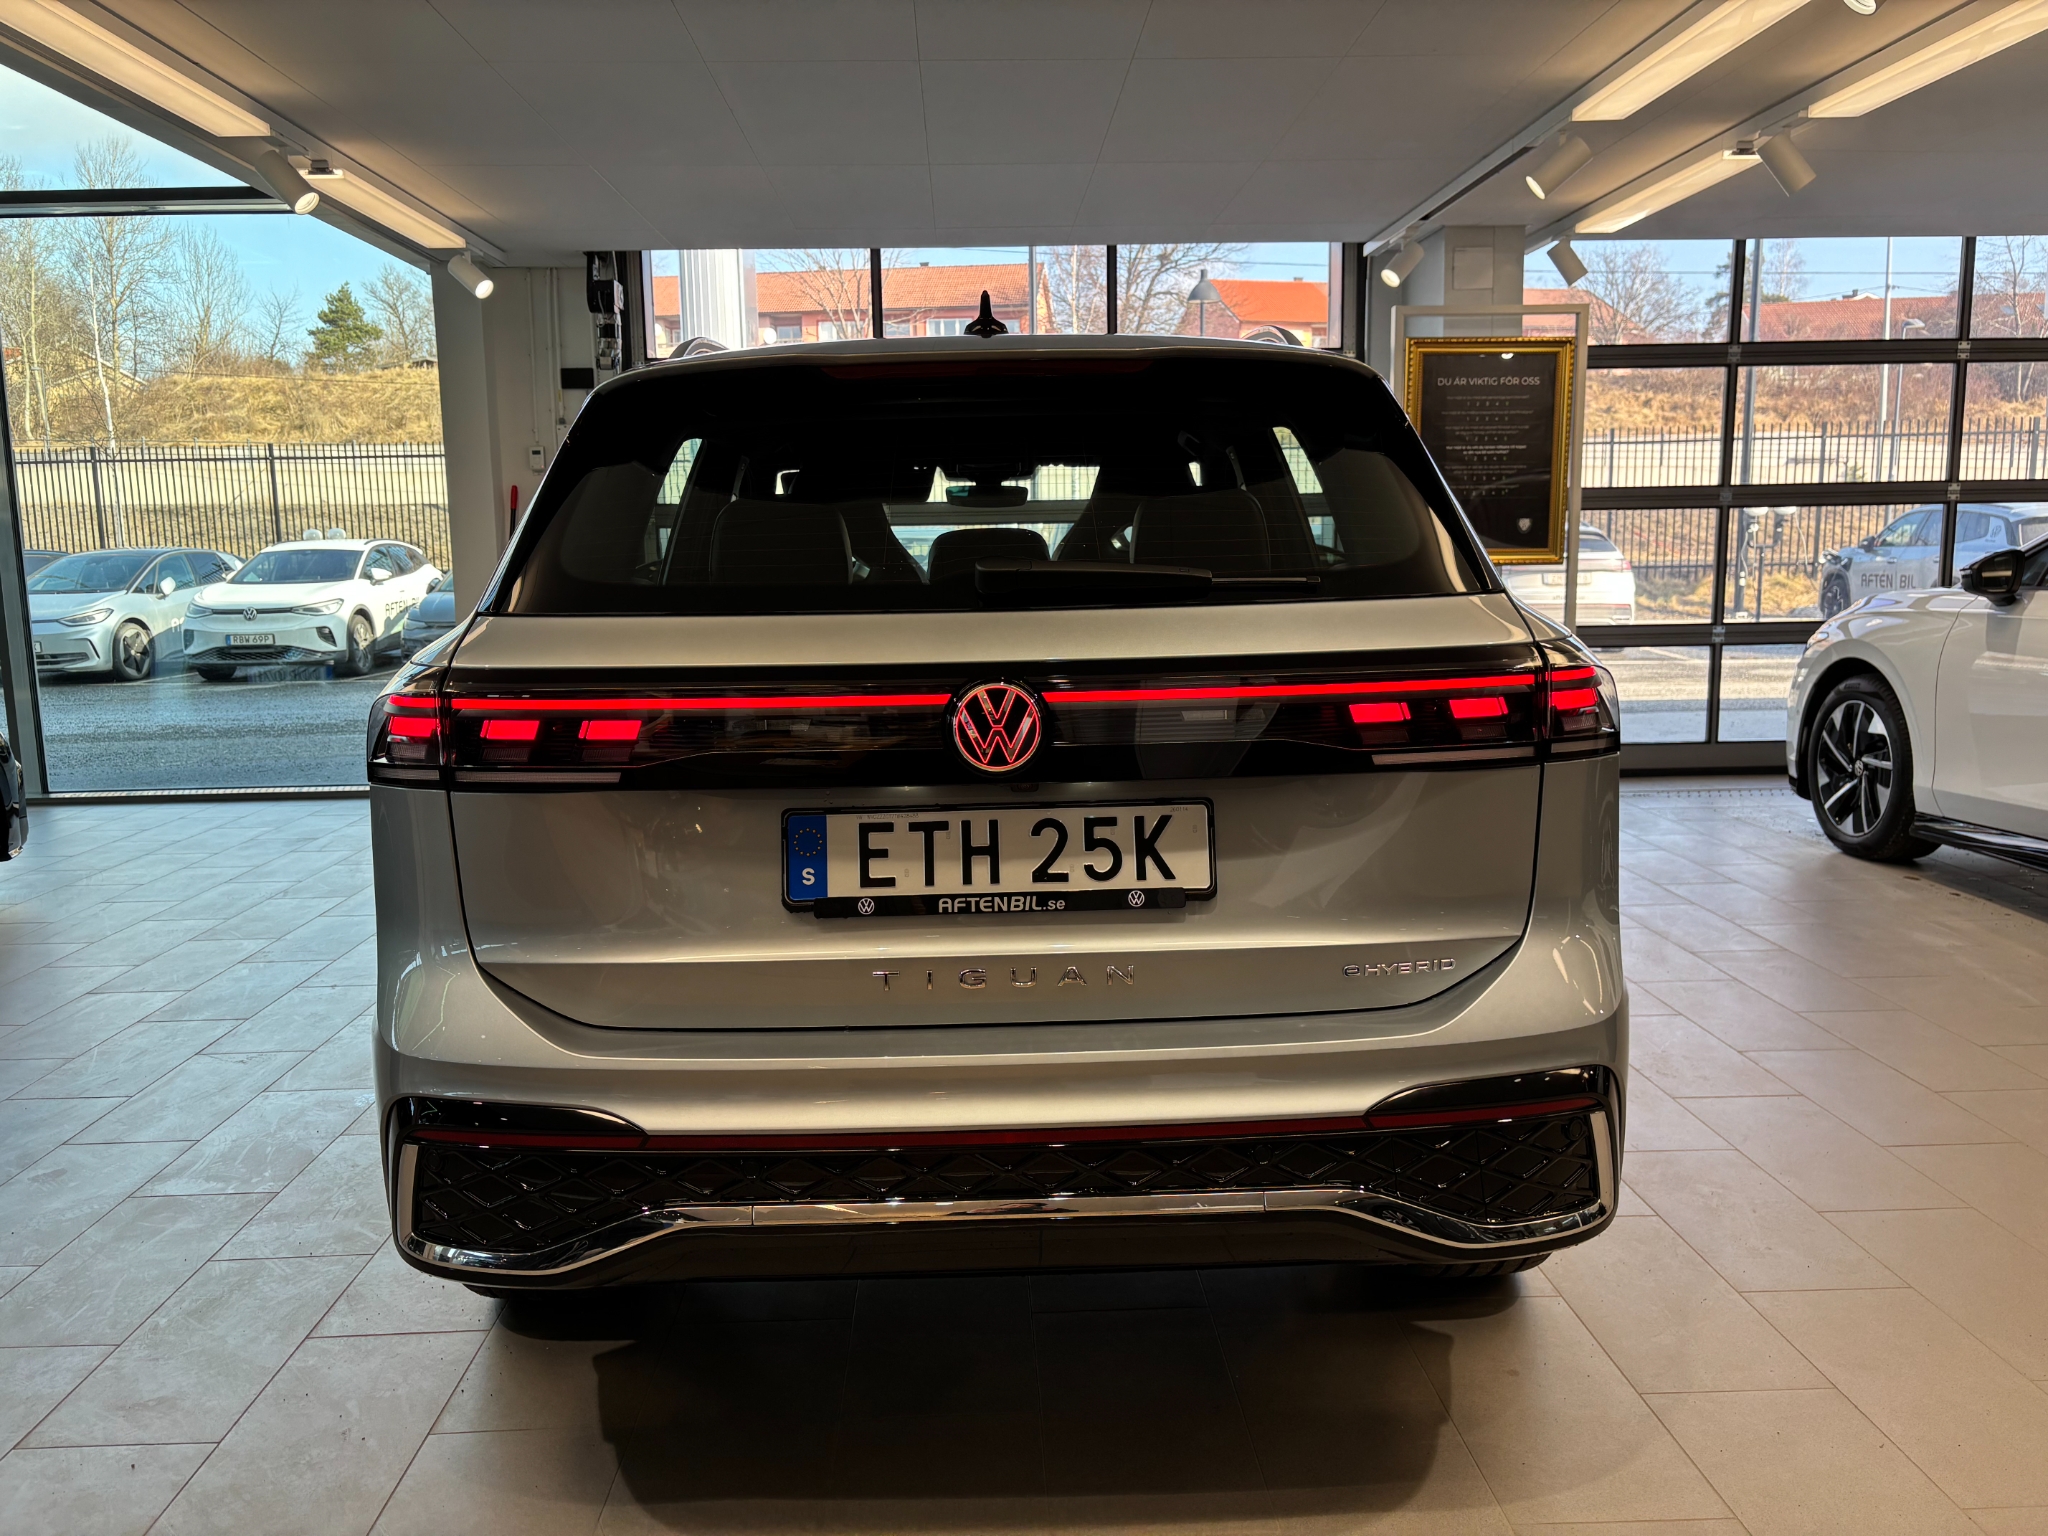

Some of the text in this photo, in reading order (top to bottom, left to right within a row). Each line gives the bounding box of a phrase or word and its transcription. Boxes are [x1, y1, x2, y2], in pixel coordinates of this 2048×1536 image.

[1437, 376, 1541, 387] DU ÄR VIKTIG FÖR OSS
[1861, 570, 1916, 589] AFTÉN BIL
[233, 635, 270, 644] RBW 69P
[858, 815, 1176, 888] ETH 25K
[802, 867, 816, 886] S
[938, 895, 1066, 913] AFTENBIL.se
[872, 965, 1134, 991] TIGUAN
